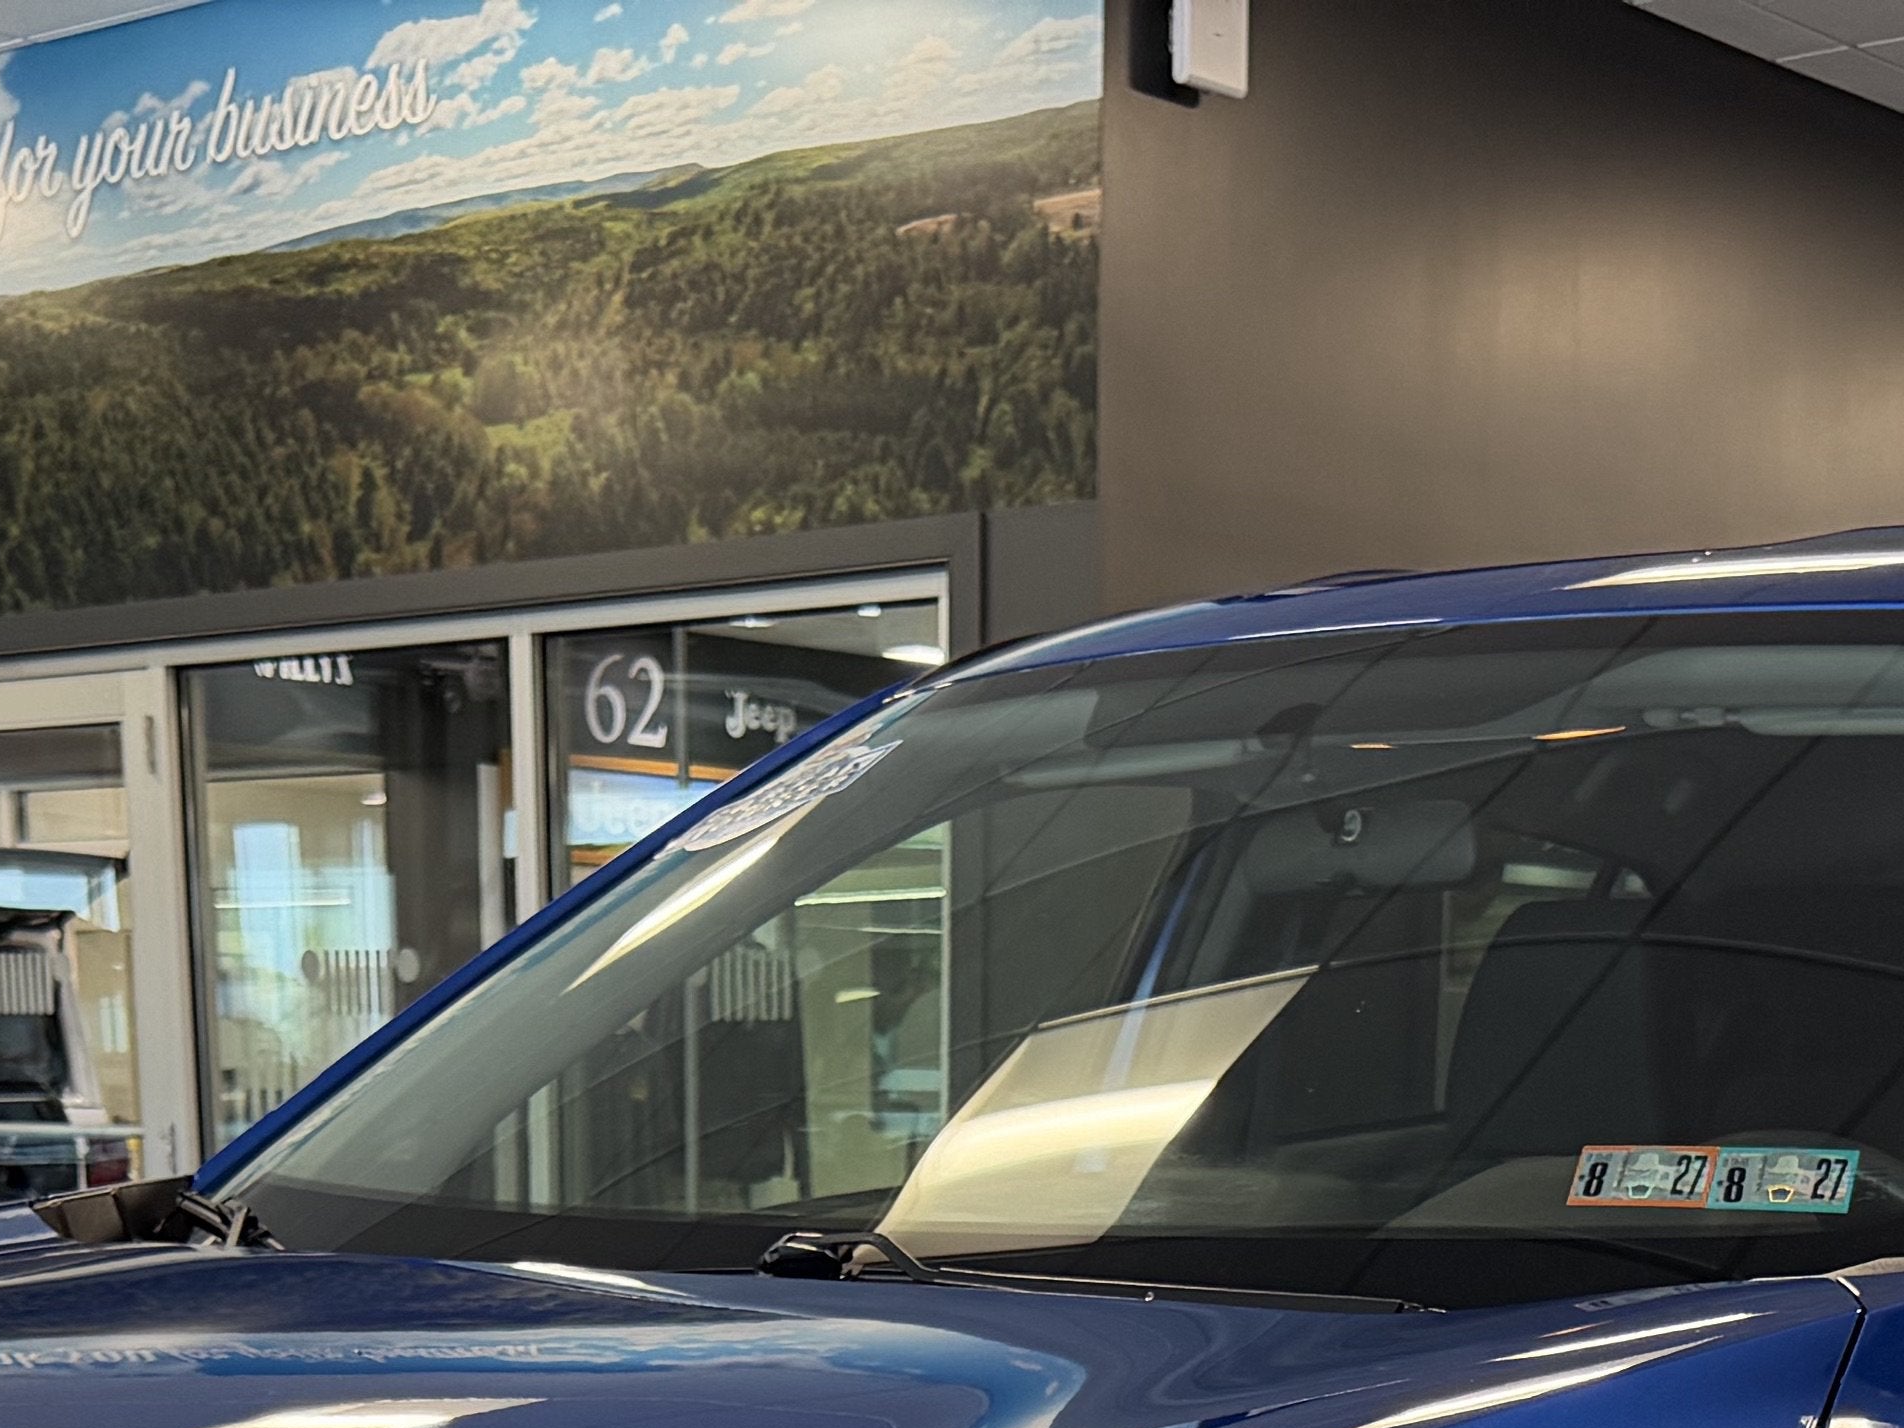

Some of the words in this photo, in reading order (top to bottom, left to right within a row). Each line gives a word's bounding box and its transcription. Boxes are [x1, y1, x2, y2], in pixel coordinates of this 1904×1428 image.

[70, 108, 199, 238] your
[206, 57, 439, 164] business
[584, 653, 668, 748] 62
[724, 688, 798, 744] Jeep
[1582, 1162, 1608, 1197] 8
[1670, 1154, 1708, 1197] 27
[1723, 1167, 1747, 1203] 8
[1811, 1158, 1848, 1201] 27
